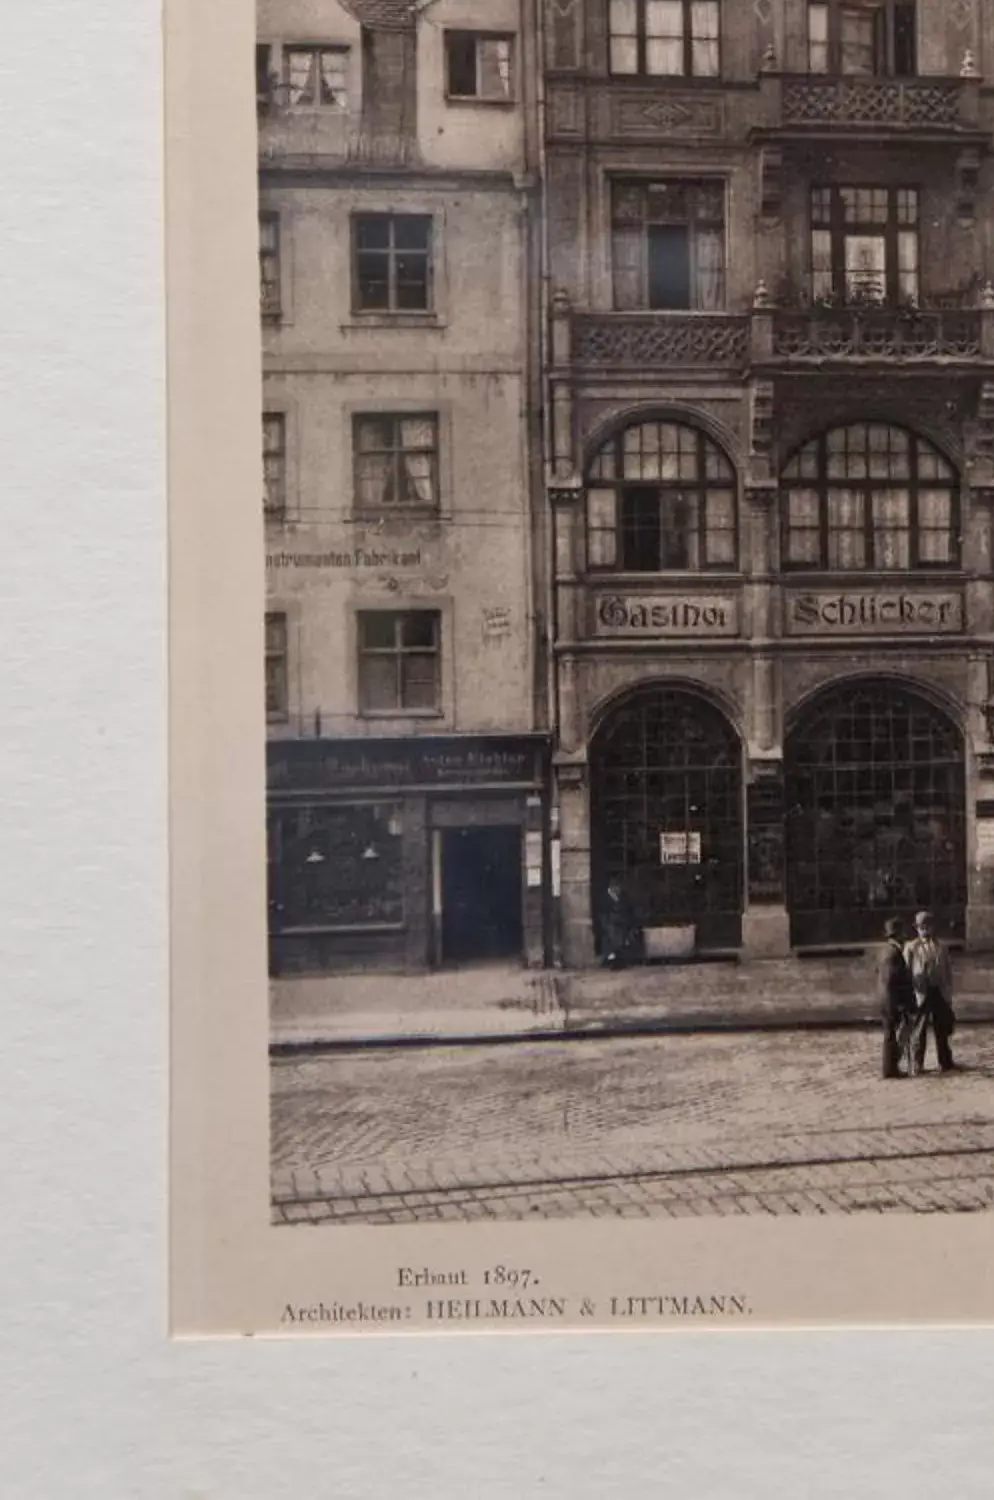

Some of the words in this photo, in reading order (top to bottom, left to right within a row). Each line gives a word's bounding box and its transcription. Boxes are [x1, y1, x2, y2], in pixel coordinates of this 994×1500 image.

[397, 1267, 469, 1288] Erbaut
[483, 1264, 540, 1290] 1897.
[280, 1300, 411, 1323] Architekten:
[426, 1298, 567, 1321] HEILMANN
[579, 1299, 596, 1317] &
[609, 1294, 753, 1317] LITTMANN.
